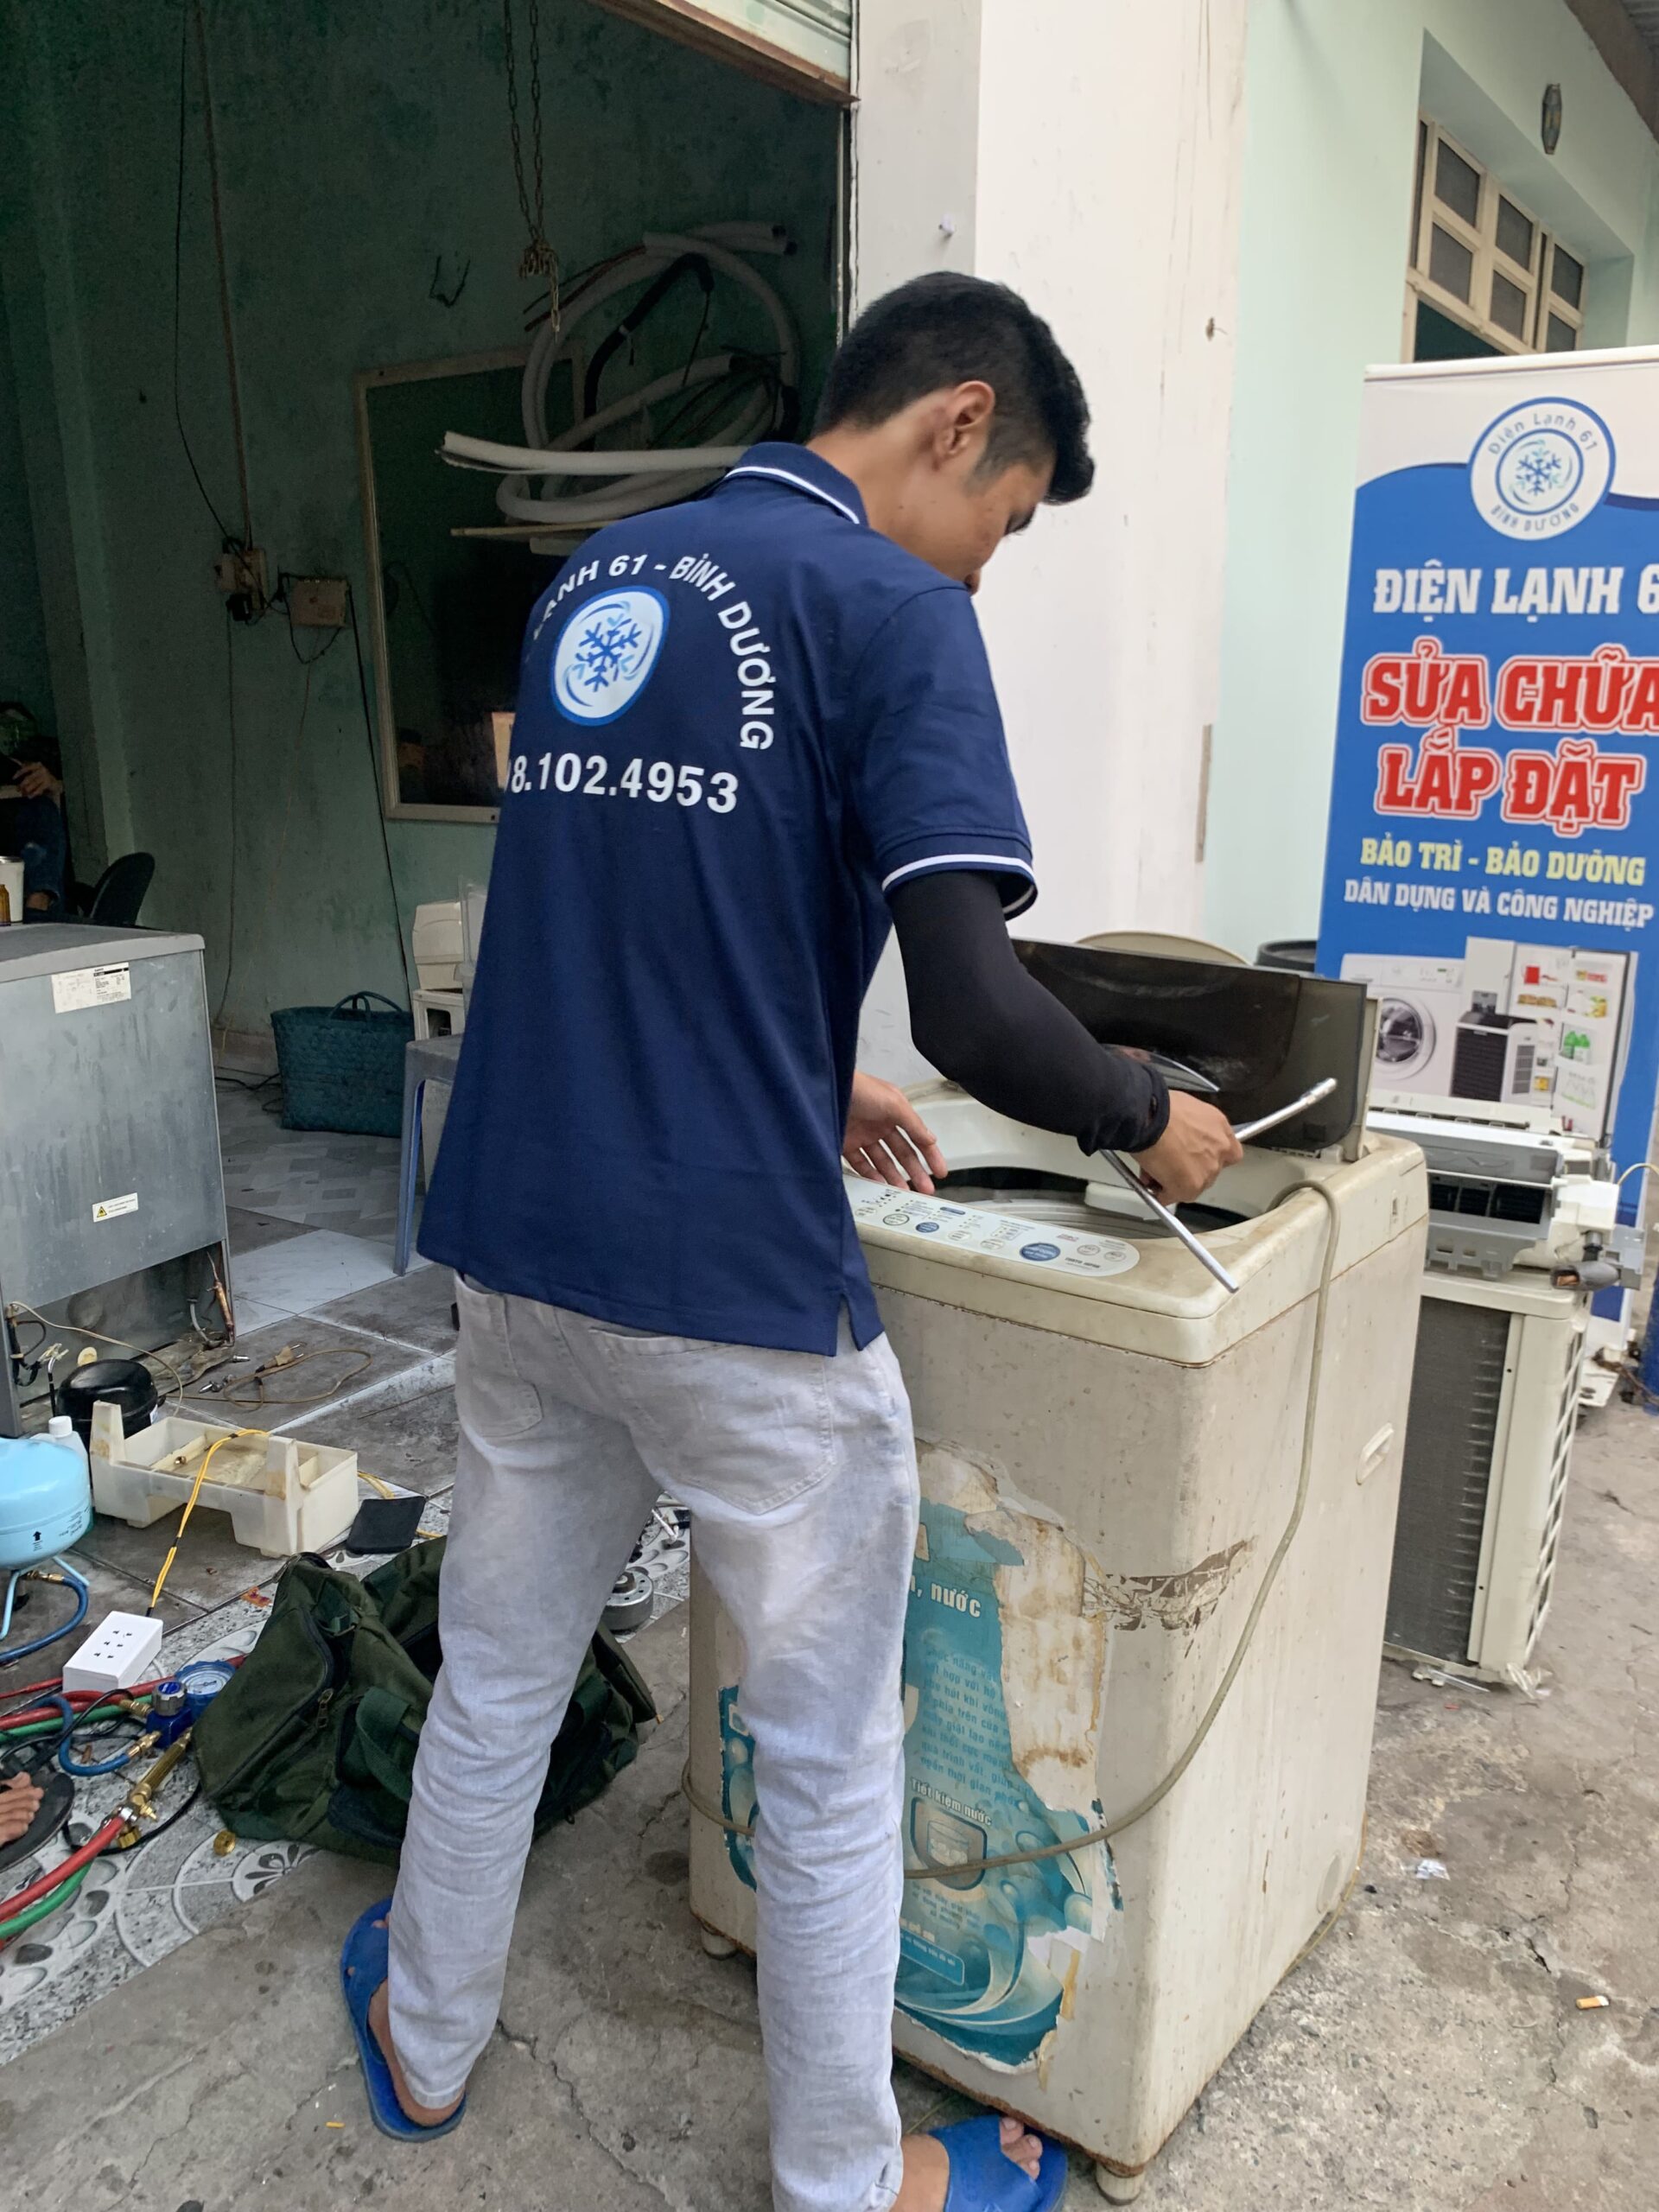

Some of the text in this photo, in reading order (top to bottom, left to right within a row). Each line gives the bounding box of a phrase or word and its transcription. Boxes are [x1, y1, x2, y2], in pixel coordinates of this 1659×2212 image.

[1579, 430, 1598, 450] 61
[1373, 559, 1482, 622] ĐIỆN
[1491, 567, 1624, 623] LẠNH
[608, 555, 648, 577] 61
[653, 563, 667, 571] -
[717, 601, 777, 750] DƯƠNG
[1363, 637, 1659, 734] SỬA CHỮA
[505, 753, 738, 813] 8.102.4953
[1375, 726, 1646, 837] LẮP ĐẶT
[1360, 831, 1646, 887] BẢO TRÌ - BẢO DƯỠNG
[1344, 875, 1654, 931] DÂN DỤNG VÀ CÔNG NGHIỆP
[931, 1582, 982, 1618] nước
[912, 1778, 992, 1826] Tiết kiệm nước
